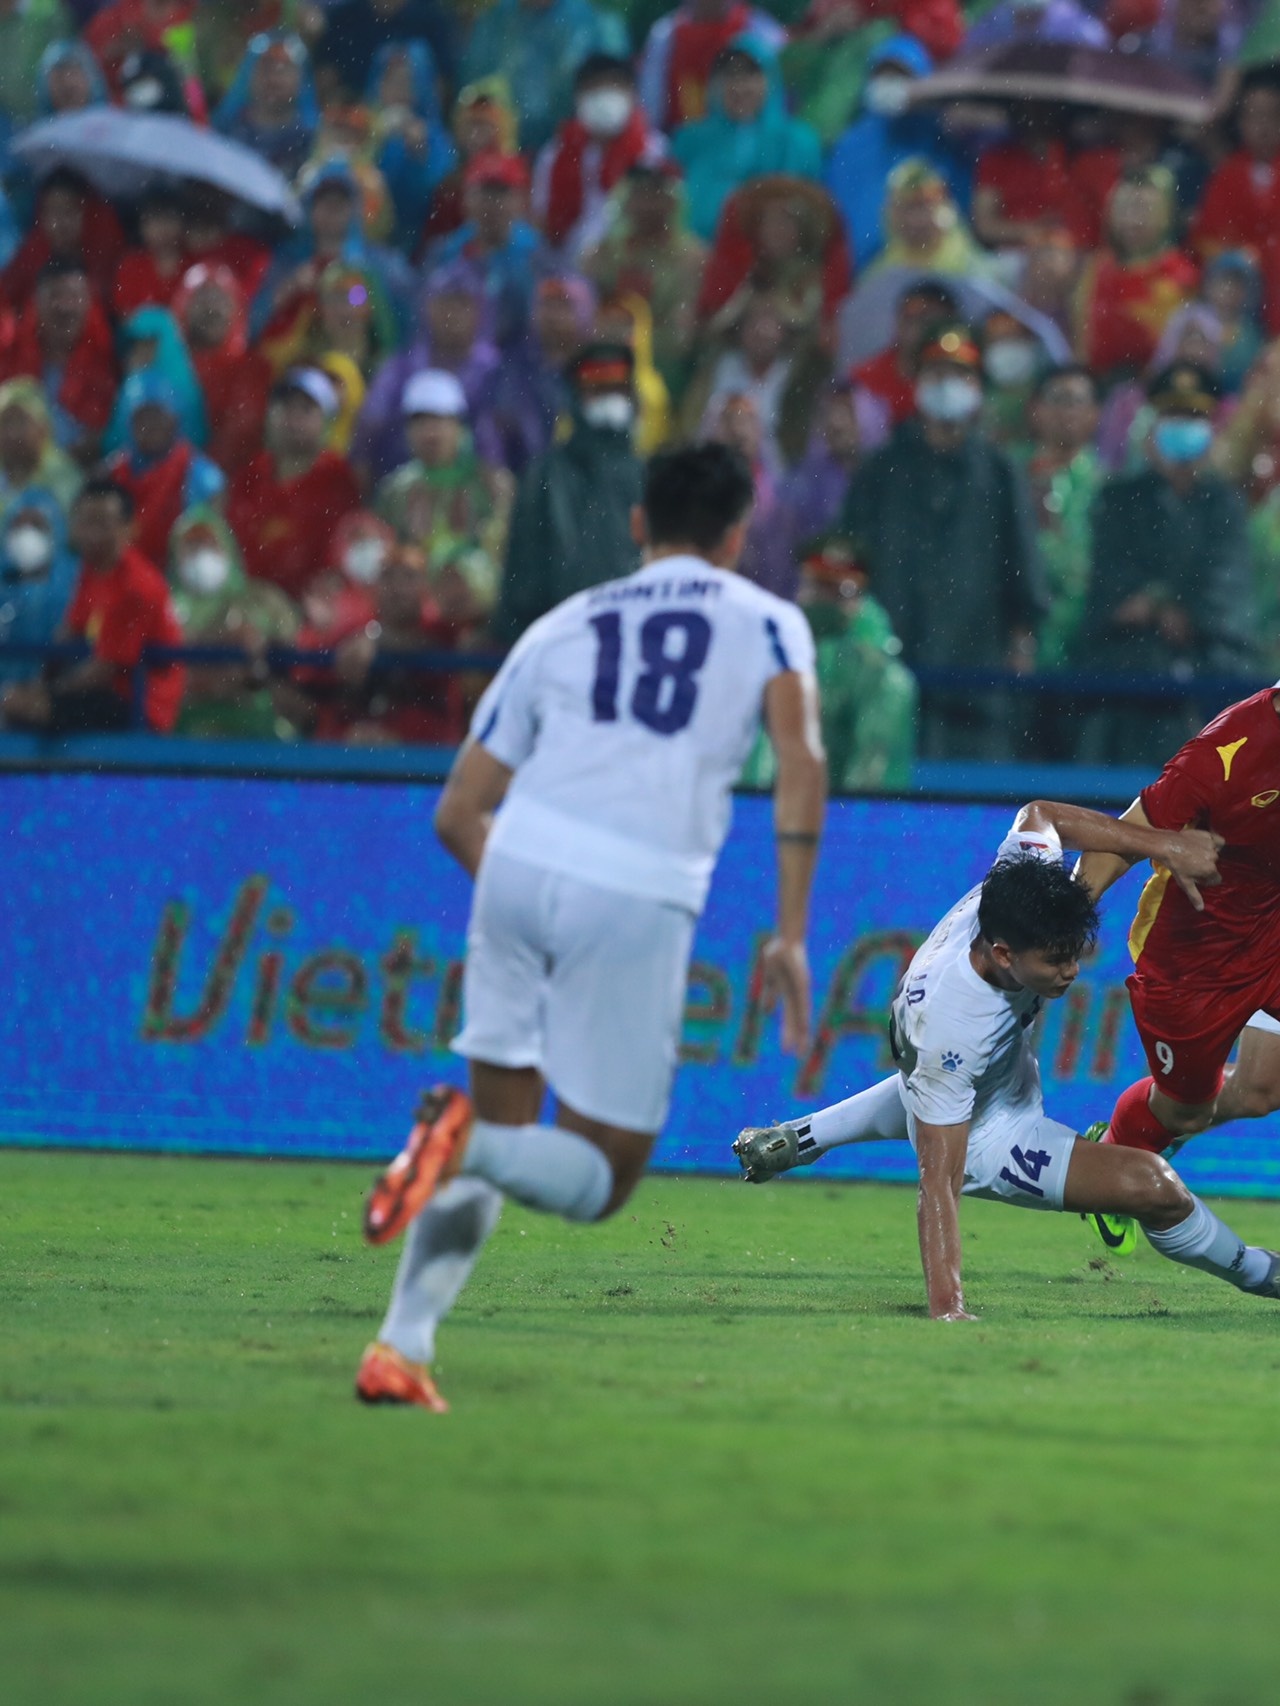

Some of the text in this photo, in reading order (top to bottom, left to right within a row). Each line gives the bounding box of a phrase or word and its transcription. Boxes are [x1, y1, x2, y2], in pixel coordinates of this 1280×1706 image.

[588, 611, 713, 737] 18
[1155, 1040, 1174, 1075] 9
[999, 1144, 1052, 1198] 14
